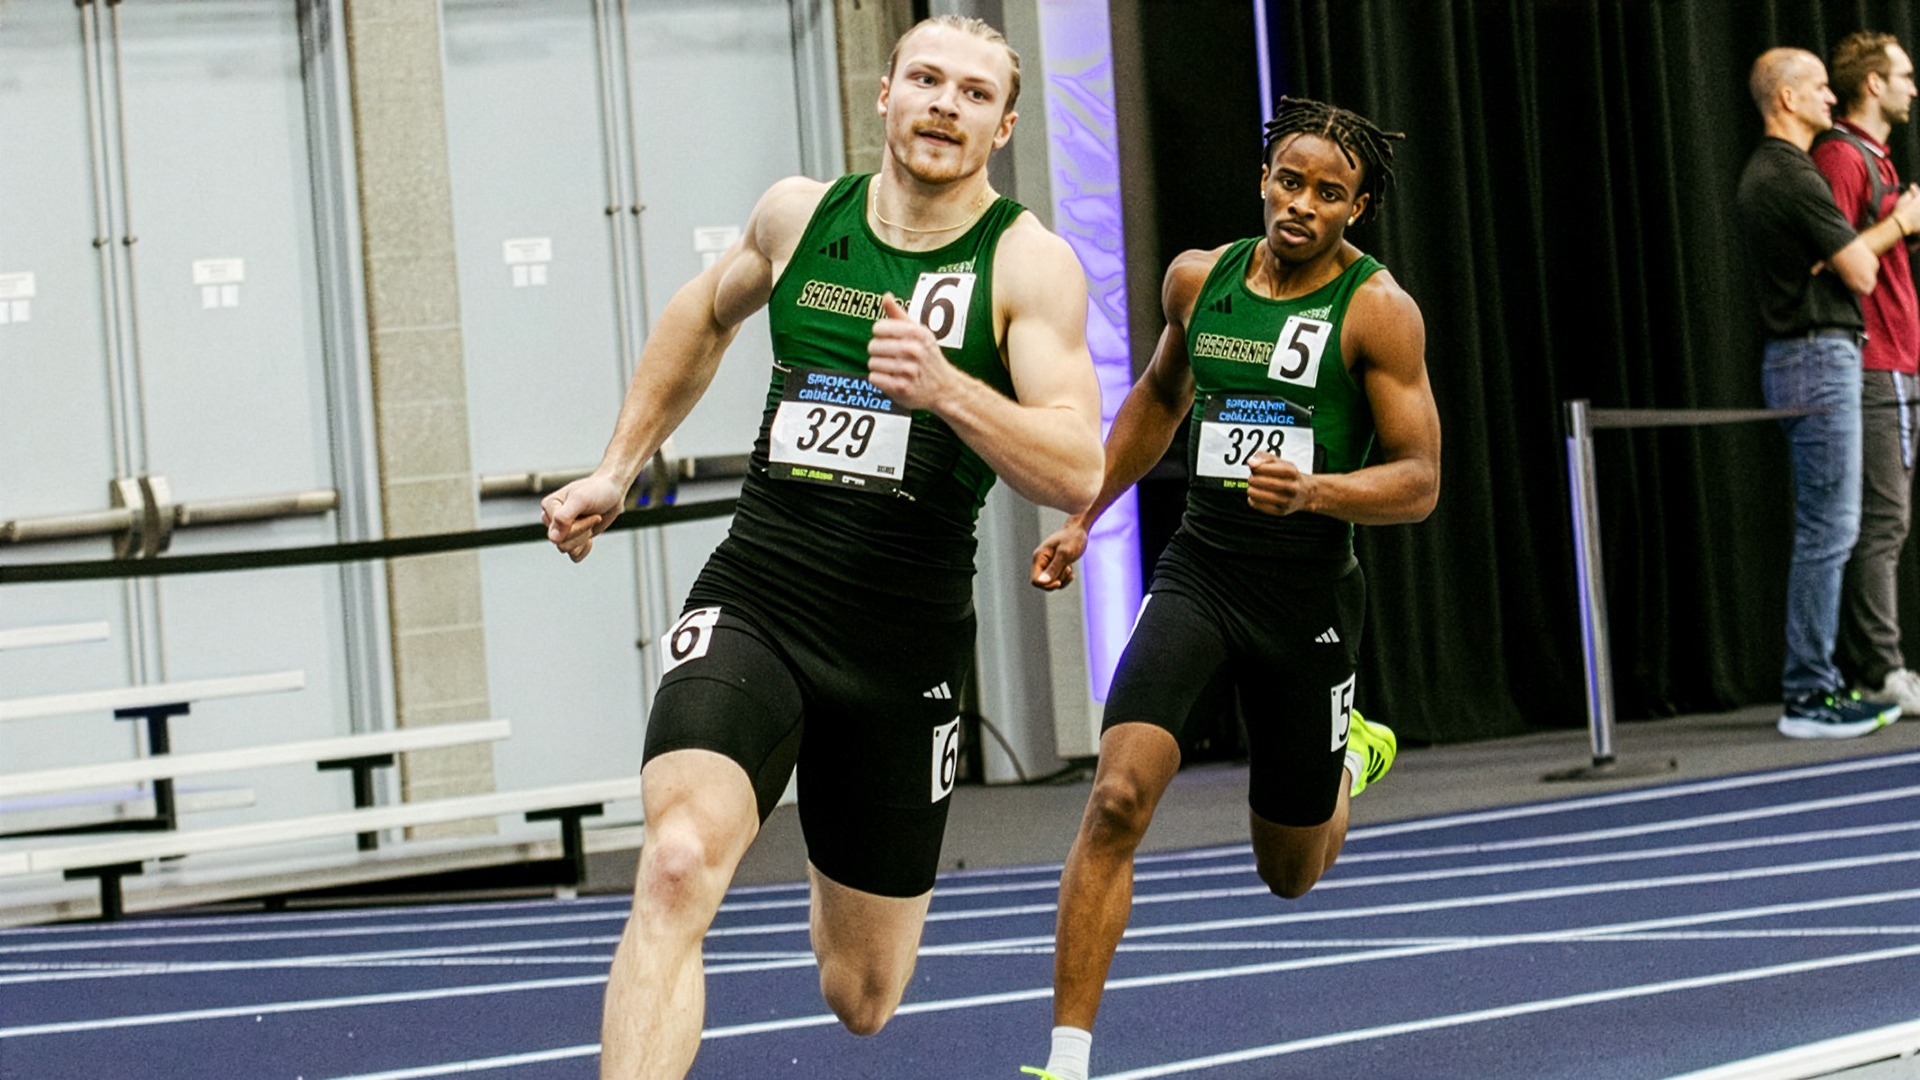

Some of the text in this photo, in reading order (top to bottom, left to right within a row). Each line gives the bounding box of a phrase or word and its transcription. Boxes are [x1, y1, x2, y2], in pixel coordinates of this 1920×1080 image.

[919, 277, 961, 340] 6
[1280, 322, 1321, 379] 5
[807, 373, 882, 394] SPOKAN
[796, 407, 876, 459] 329
[1223, 427, 1285, 466] 328
[671, 609, 708, 661] 6
[1339, 683, 1352, 742] 5
[941, 722, 958, 791] 6
